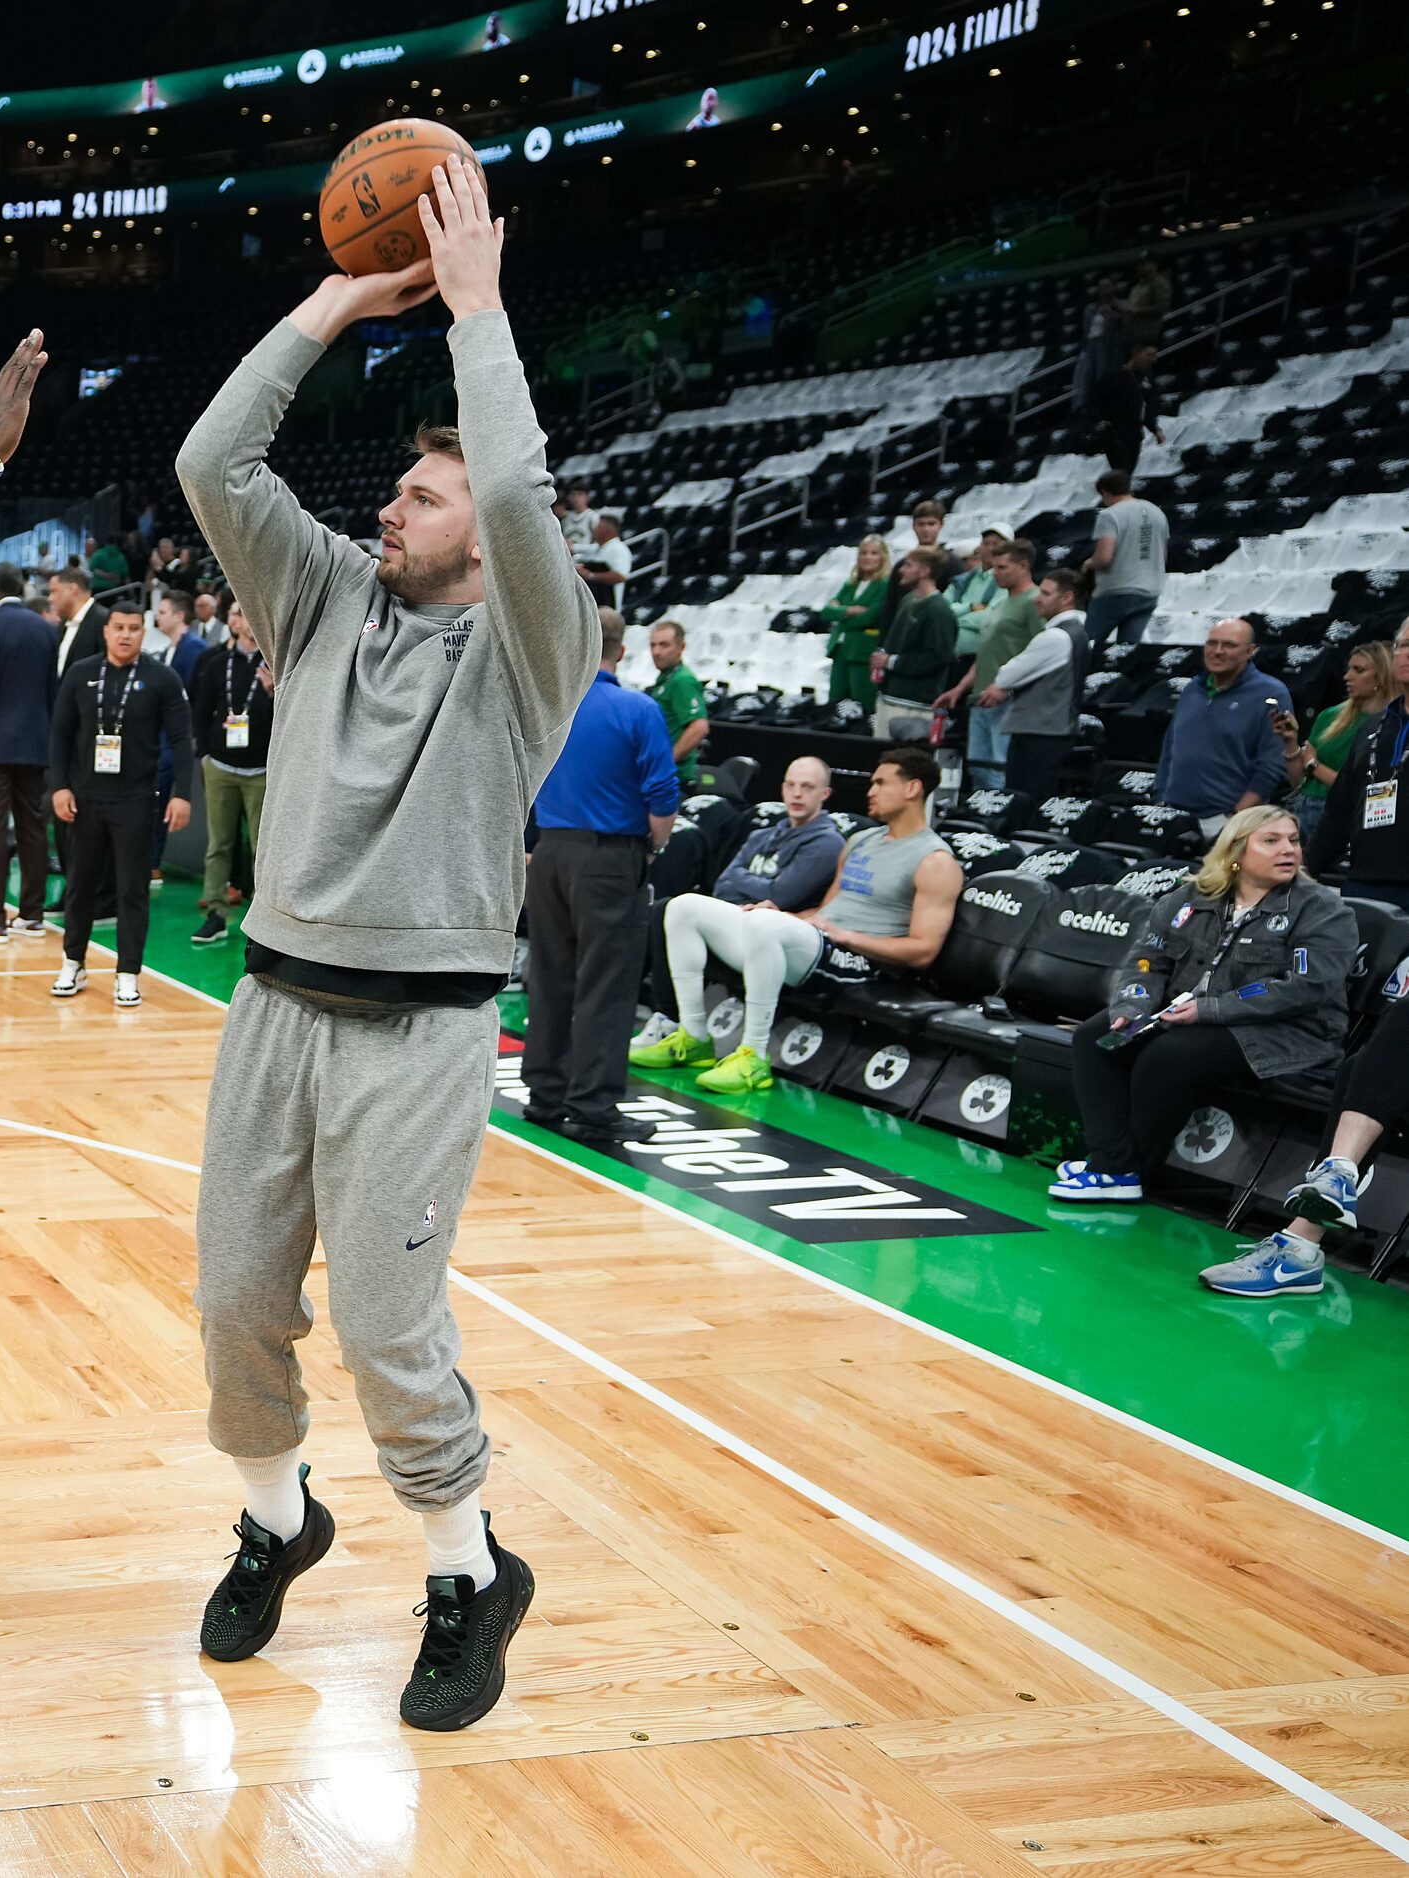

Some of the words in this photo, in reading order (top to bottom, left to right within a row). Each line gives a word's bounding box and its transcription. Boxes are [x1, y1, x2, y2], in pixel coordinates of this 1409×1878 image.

[904, 22, 957, 72] 2024
[961, 0, 1040, 53] FINALS
[2, 202, 34, 220] 6:31
[36, 199, 61, 217] PM
[103, 185, 168, 218] FINALS
[446, 619, 474, 633] ALLAS
[962, 887, 1022, 916] @celtics
[1058, 909, 1130, 937] @celtics
